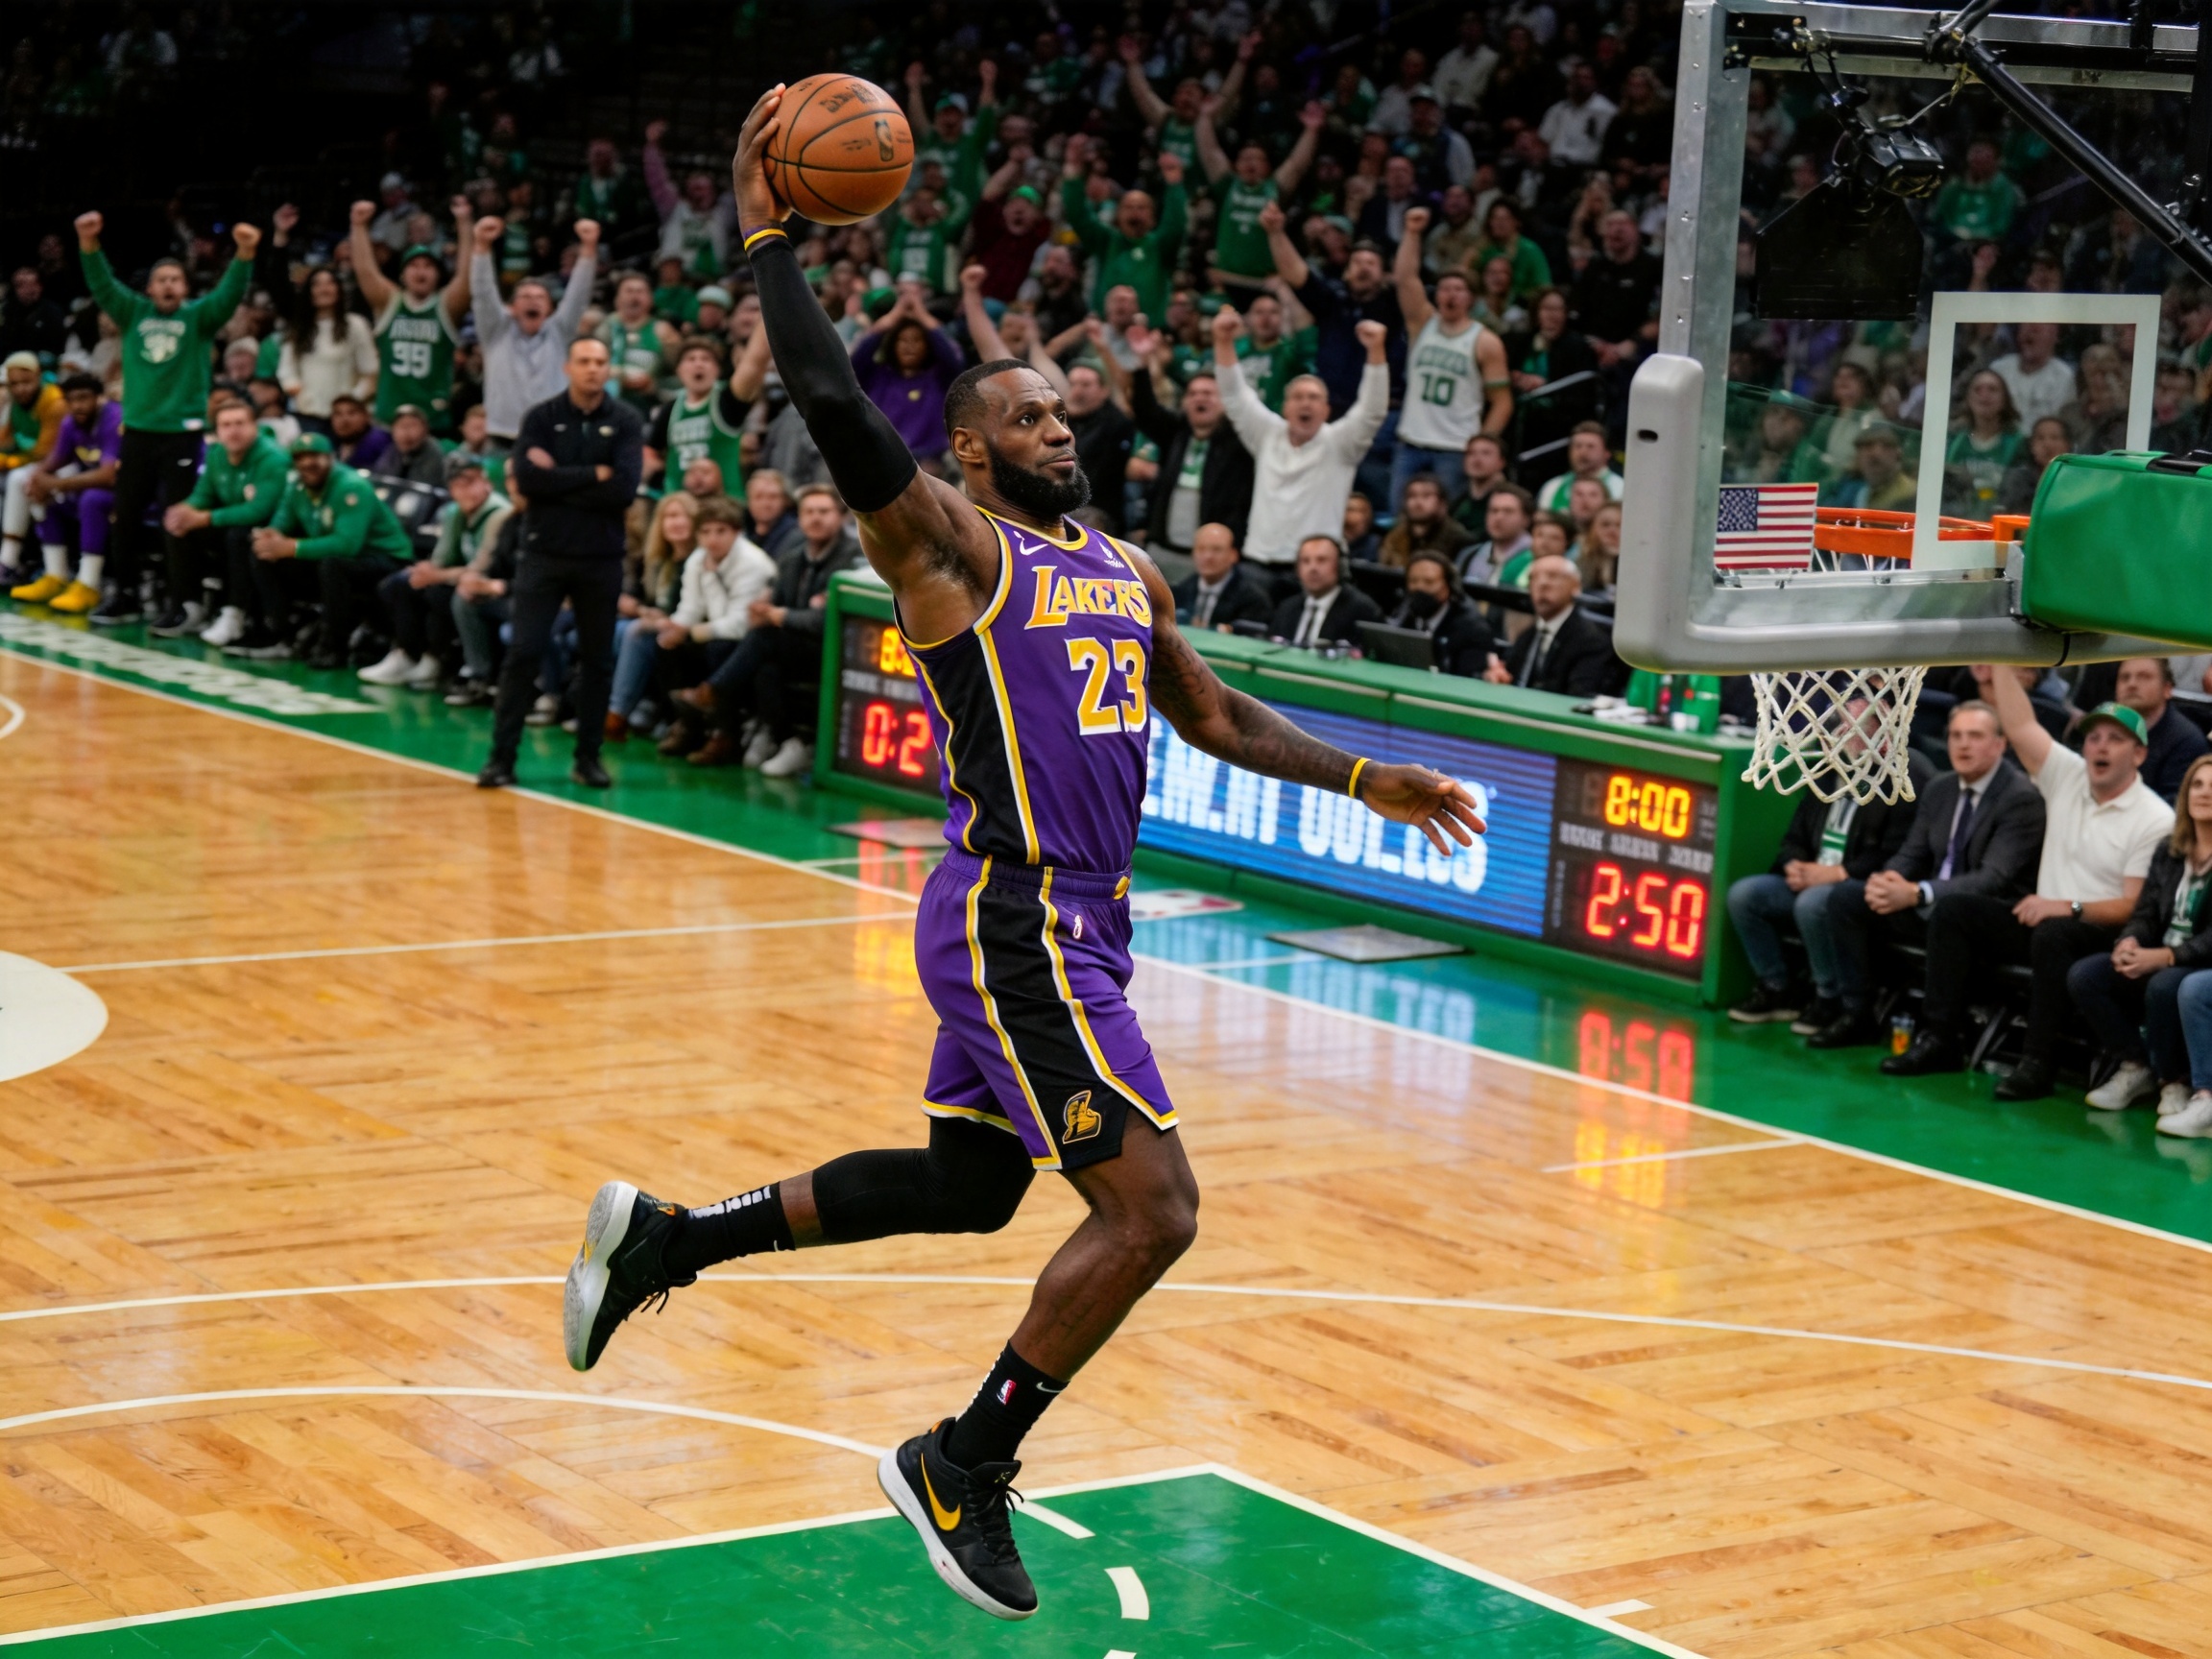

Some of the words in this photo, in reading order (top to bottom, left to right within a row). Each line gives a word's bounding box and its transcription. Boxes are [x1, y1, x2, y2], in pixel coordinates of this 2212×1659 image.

[1023, 565, 1152, 630] LAKERS
[1065, 637, 1148, 736] 23
[1605, 775, 1691, 838] 8:00
[1586, 864, 1705, 959] 2:50
